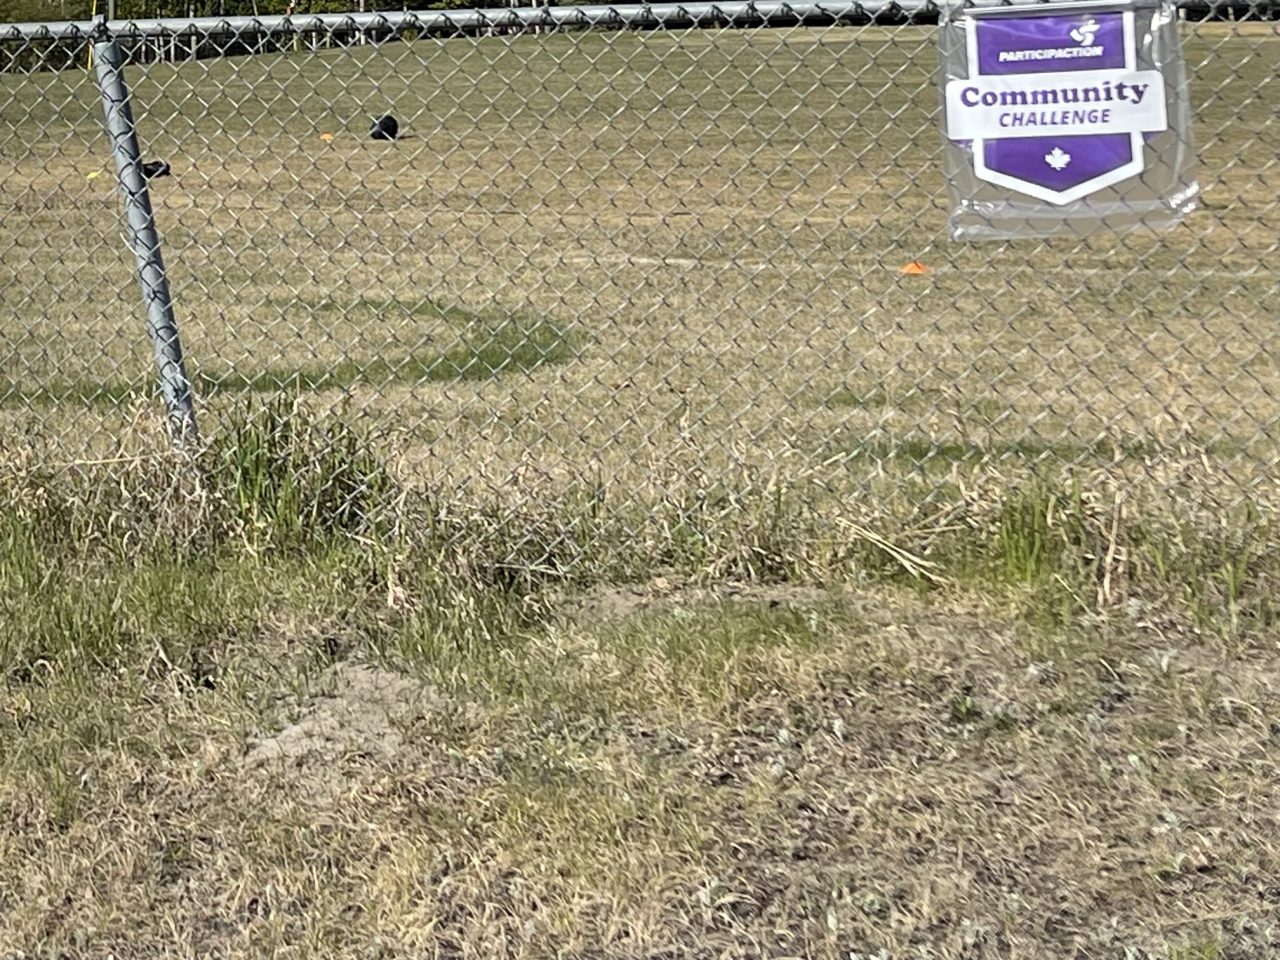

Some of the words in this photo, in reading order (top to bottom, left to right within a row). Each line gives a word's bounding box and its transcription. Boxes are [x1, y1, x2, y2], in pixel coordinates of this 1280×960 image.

[999, 46, 1104, 62] PARTICIPACTION
[960, 81, 1148, 107] Community
[999, 109, 1111, 127] CHALLENGE
